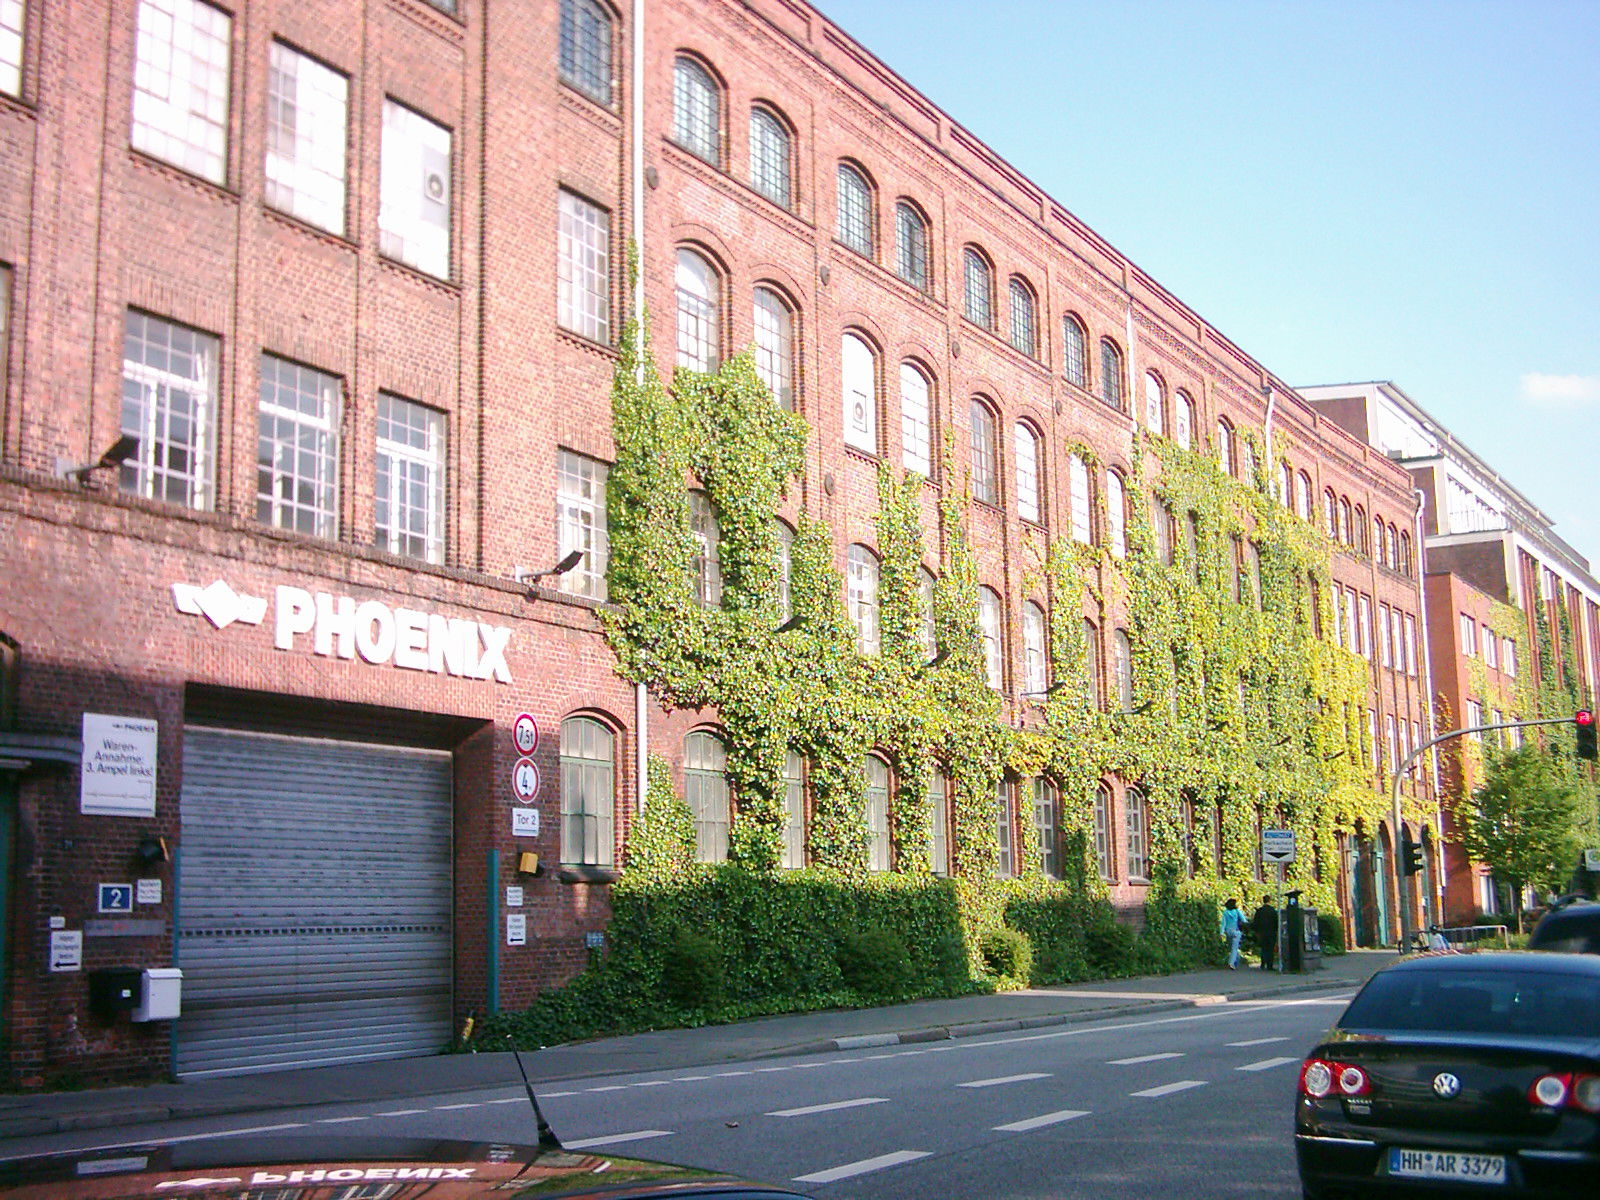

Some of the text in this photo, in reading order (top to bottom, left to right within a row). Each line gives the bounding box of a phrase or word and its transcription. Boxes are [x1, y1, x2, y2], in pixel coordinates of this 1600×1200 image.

[272, 584, 514, 685] PHOENIX
[96, 763, 128, 776] Ampel
[516, 814, 537, 826] Tor 2
[110, 888, 122, 907] 2
[1401, 1152, 1503, 1176] HH AR 3379
